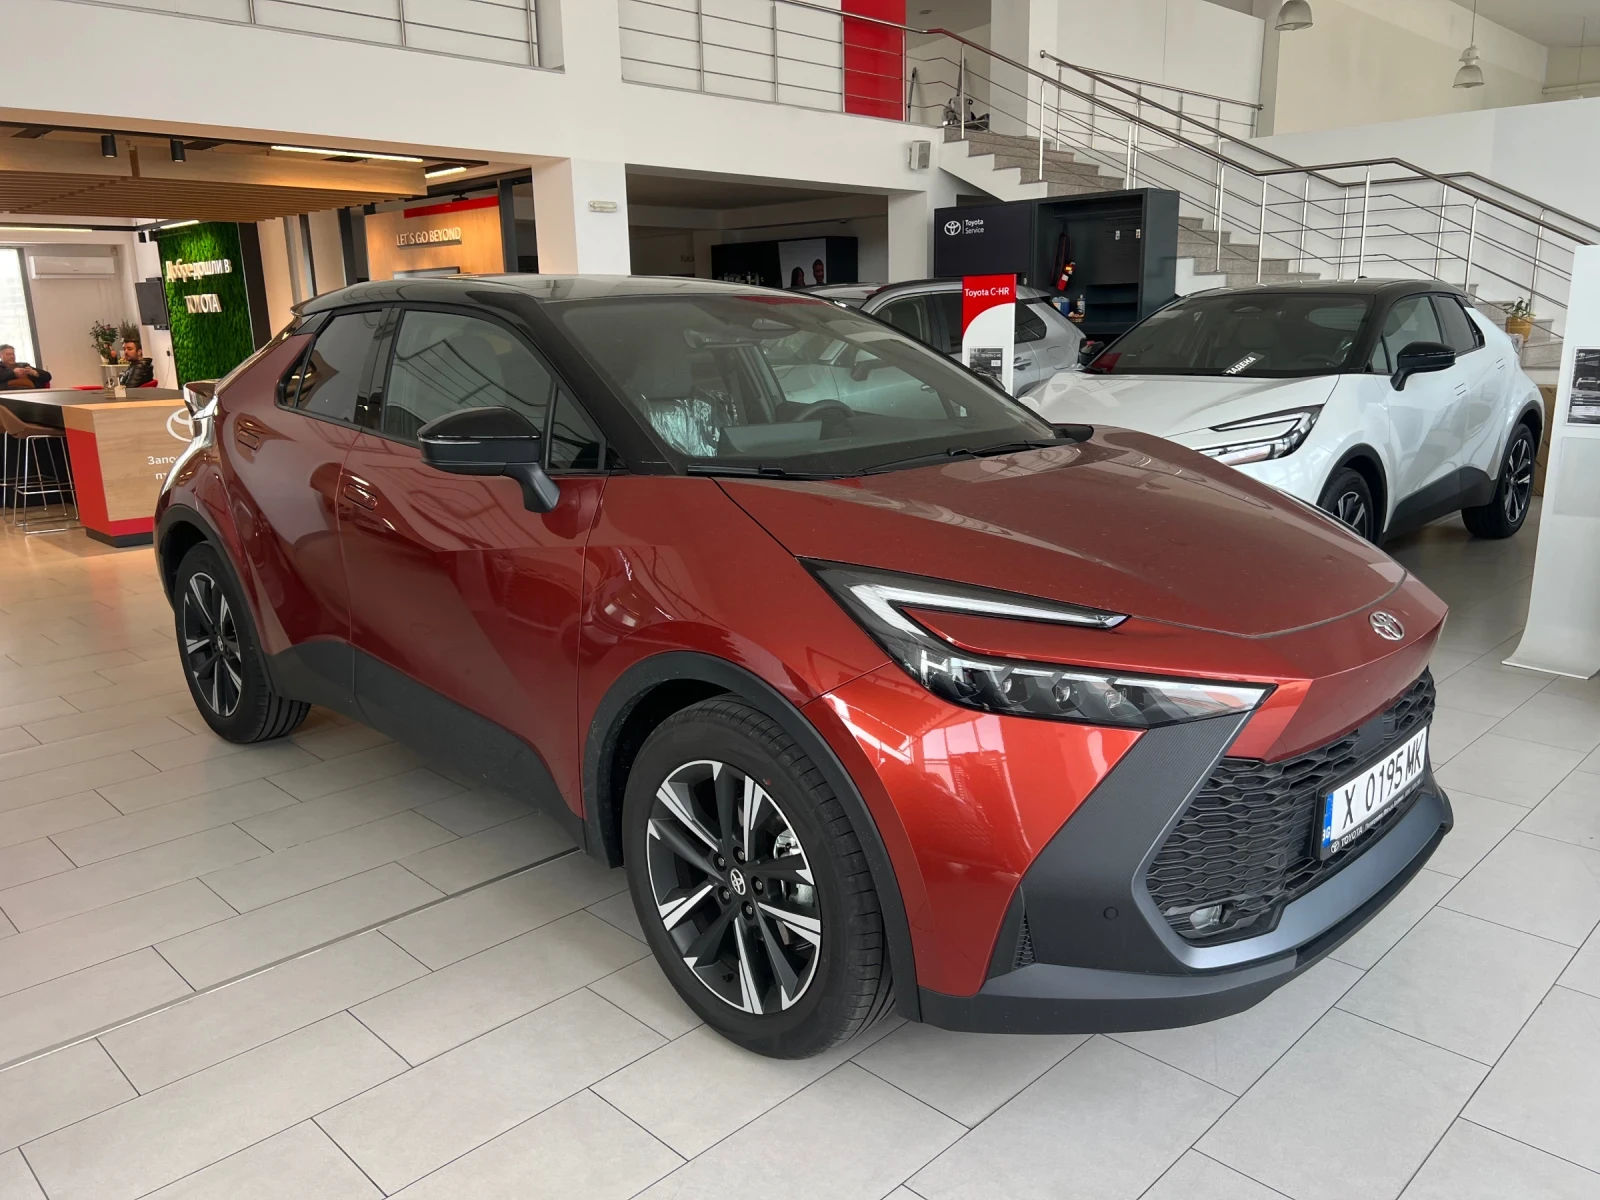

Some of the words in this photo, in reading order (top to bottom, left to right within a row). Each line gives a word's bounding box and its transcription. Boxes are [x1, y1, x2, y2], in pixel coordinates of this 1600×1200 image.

[965, 219, 984, 227] Toyota
[415, 231, 429, 244] GO
[964, 288, 989, 298] Toyota
[990, 287, 1010, 296] C-HR
[184, 294, 222, 314] TOYOTA
[147, 455, 178, 465] Запо
[1342, 783, 1356, 830] X
[1365, 750, 1404, 812] 0195
[1405, 733, 1424, 781] MK
[1340, 827, 1363, 847] TOYOTA
